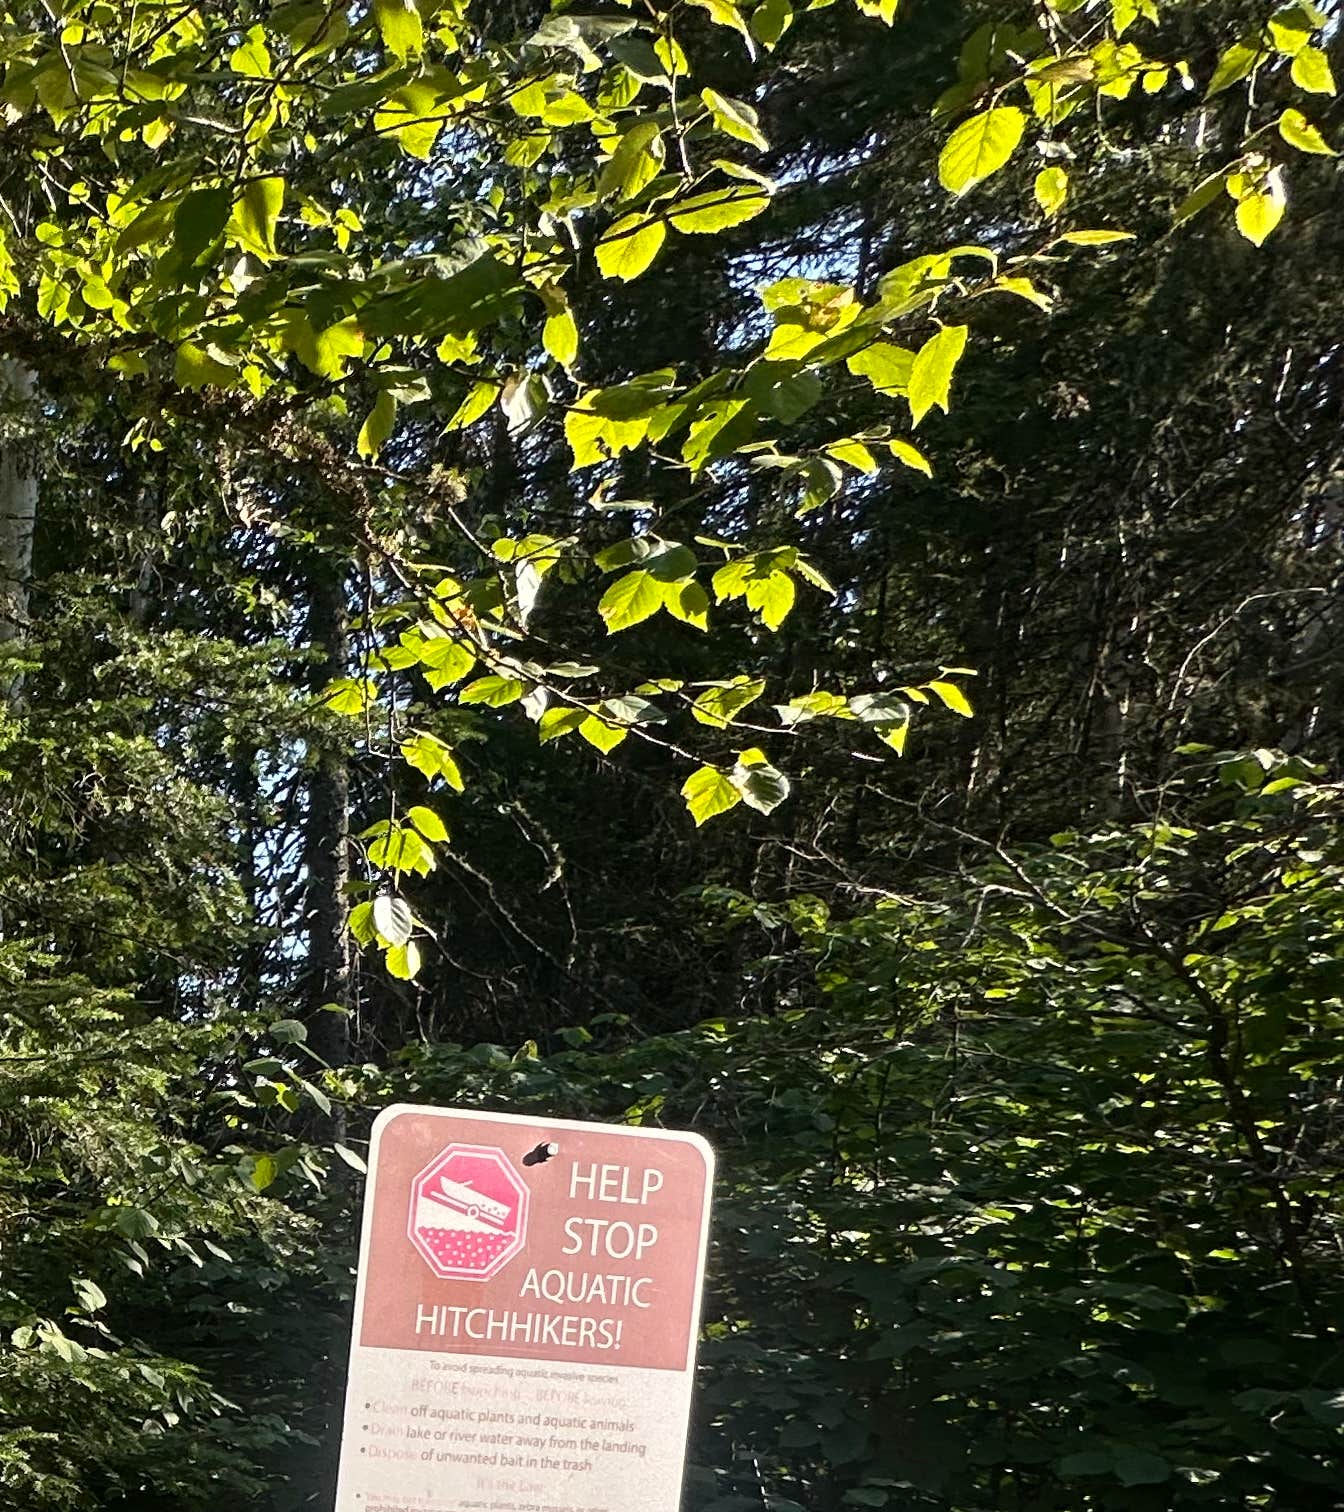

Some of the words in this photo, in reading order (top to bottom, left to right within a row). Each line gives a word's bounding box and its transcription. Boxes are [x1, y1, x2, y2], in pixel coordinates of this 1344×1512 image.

[569, 1161, 664, 1205] HELP
[562, 1216, 659, 1260] STOP
[519, 1268, 653, 1308] AQUATIC
[415, 1304, 623, 1350] HITCHHIKERS!
[429, 1360, 441, 1370] To
[410, 1404, 429, 1418] off
[430, 1408, 475, 1422] aquatic
[477, 1410, 514, 1424] plants
[517, 1413, 541, 1426] and
[542, 1415, 588, 1430] aquatic
[590, 1419, 635, 1433] animals
[406, 1425, 431, 1440] lake
[433, 1431, 447, 1441] or
[449, 1430, 477, 1443] river
[479, 1433, 514, 1446] water
[515, 1437, 547, 1451] away
[548, 1435, 577, 1449] from
[580, 1437, 600, 1451] the
[602, 1438, 647, 1458] landing
[420, 1447, 435, 1461] of
[436, 1450, 498, 1465] unwanted
[499, 1452, 524, 1468] bait
[526, 1457, 538, 1468] in
[540, 1456, 560, 1470] the
[562, 1458, 592, 1471] trash
